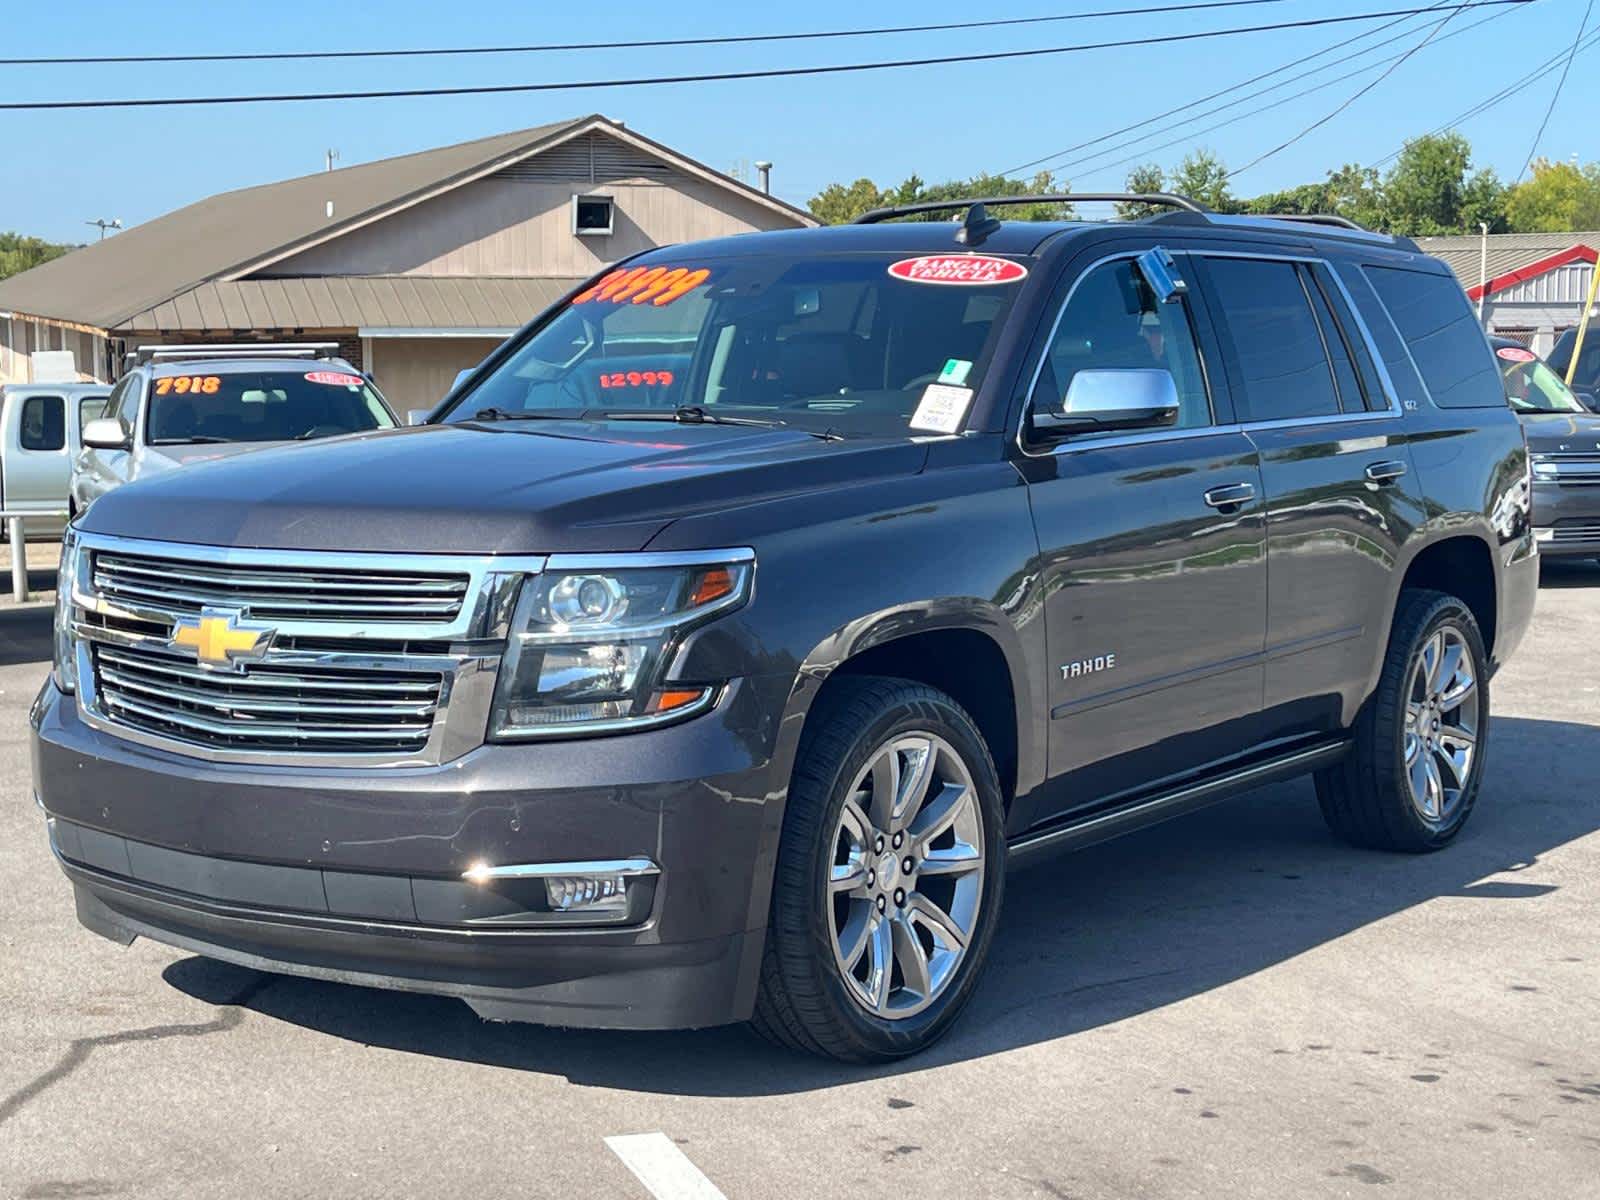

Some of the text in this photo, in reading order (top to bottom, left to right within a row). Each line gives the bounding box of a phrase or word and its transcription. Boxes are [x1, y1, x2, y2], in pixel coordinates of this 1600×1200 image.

[913, 258, 1009, 272] BARGAIN
[909, 268, 1002, 281] VEHICLE
[155, 376, 222, 395] 7918
[600, 371, 674, 388] 12999
[1060, 653, 1116, 680] TAHOE
